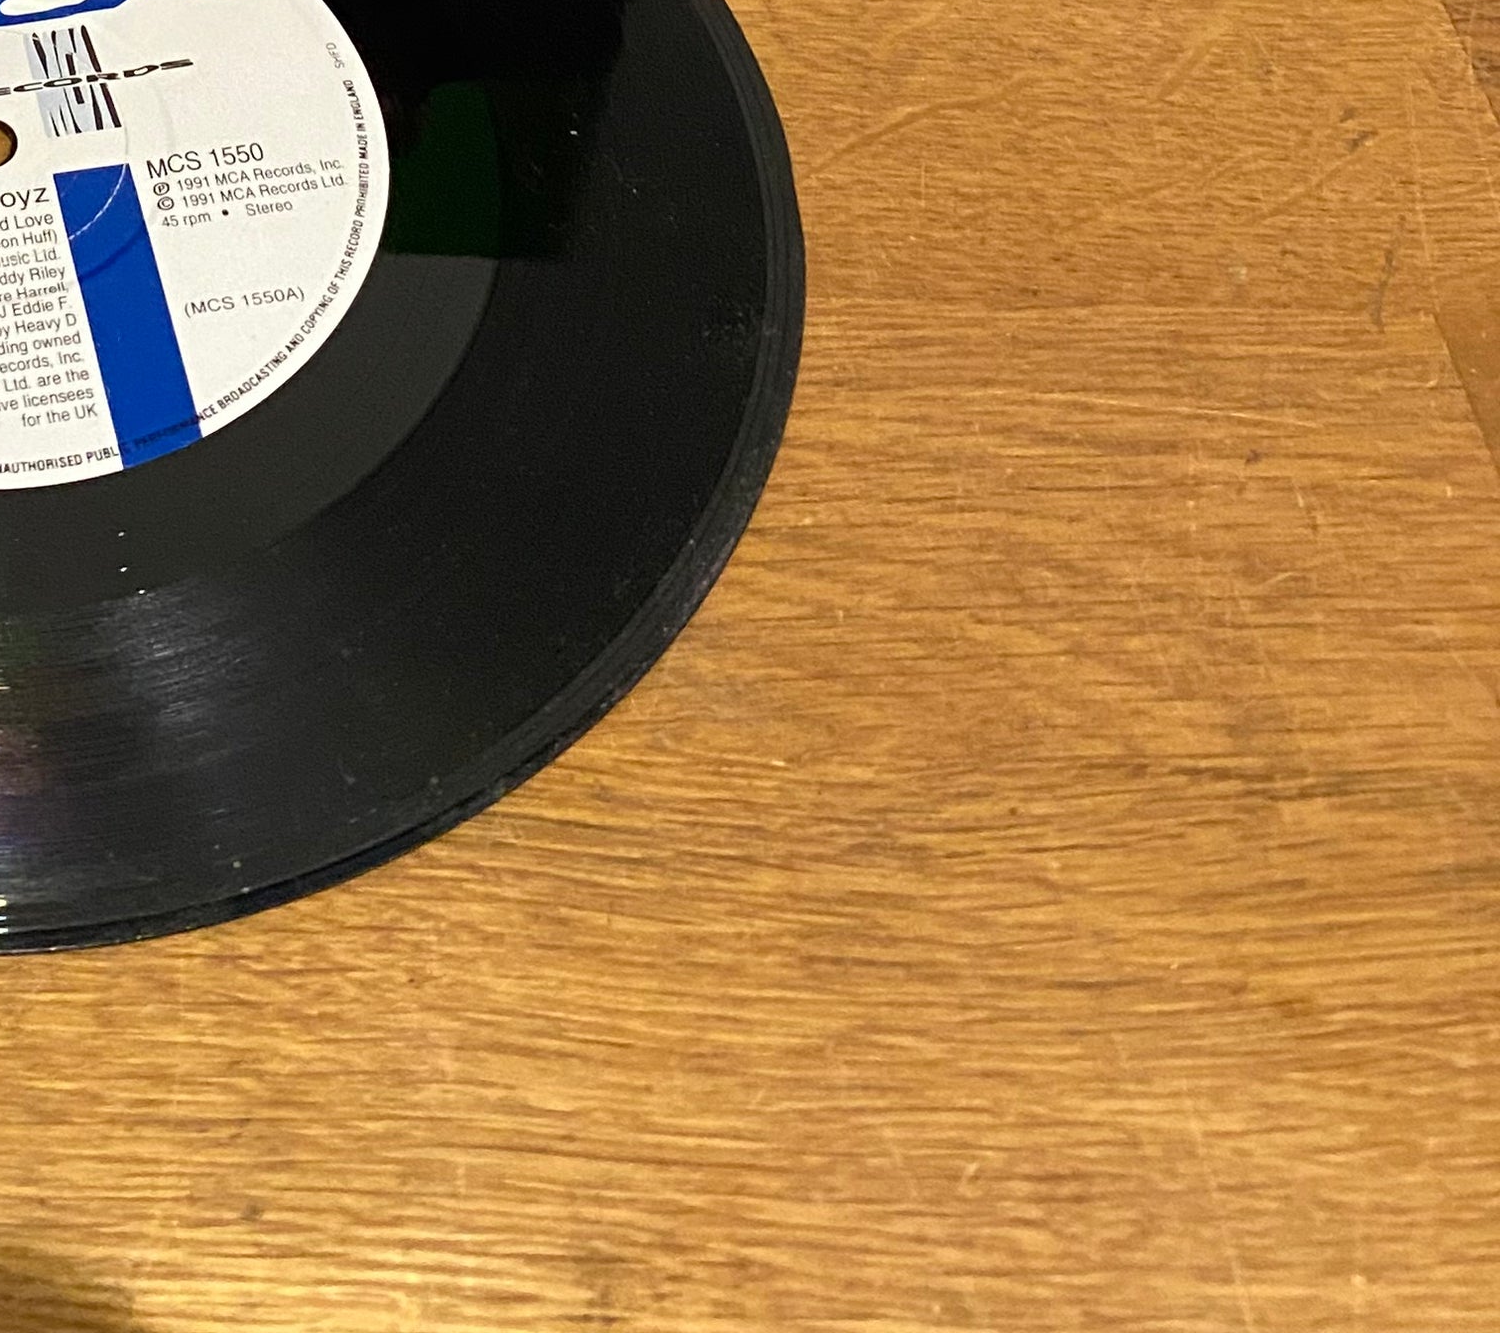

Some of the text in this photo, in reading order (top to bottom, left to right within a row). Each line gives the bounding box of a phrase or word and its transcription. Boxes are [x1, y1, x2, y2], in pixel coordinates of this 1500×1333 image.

[343, 79, 364, 121] ENGLAND
[356, 122, 367, 133] IN
[358, 134, 368, 160] MADE
[146, 142, 264, 179] MCS 1550
[177, 176, 210, 192] 1991
[215, 170, 250, 186] MCA
[253, 161, 317, 182] Records,
[319, 158, 344, 172] Inc.
[182, 192, 216, 208] 1991
[220, 187, 256, 203] MCA
[259, 178, 318, 197] Records
[321, 174, 348, 189] Ltd.
[354, 162, 369, 218] PROHIBITED
[13, 213, 54, 230] Love
[162, 200, 293, 228] 45 rpm Stereo
[22, 229, 58, 245] Huff)
[348, 219, 364, 259] RECORD
[33, 248, 61, 264] Ltd.
[29, 265, 66, 282] Riley
[334, 258, 353, 282] THIS
[327, 280, 341, 296] OF
[12, 300, 54, 316] Eddie
[58, 296, 73, 310] F.
[184, 286, 306, 319] (MCS 1550A)
[15, 317, 61, 334] Heavy
[65, 313, 77, 327] D
[300, 294, 334, 336] COPYING
[33, 330, 81, 350] owned
[284, 333, 306, 354] AND
[58, 351, 84, 365] Inc.
[3, 376, 32, 392] Ltd.
[37, 373, 61, 387] are
[65, 369, 90, 383] the
[217, 350, 288, 410] BROADCASTING
[22, 387, 94, 408] licensees
[21, 403, 98, 427] for the UK
